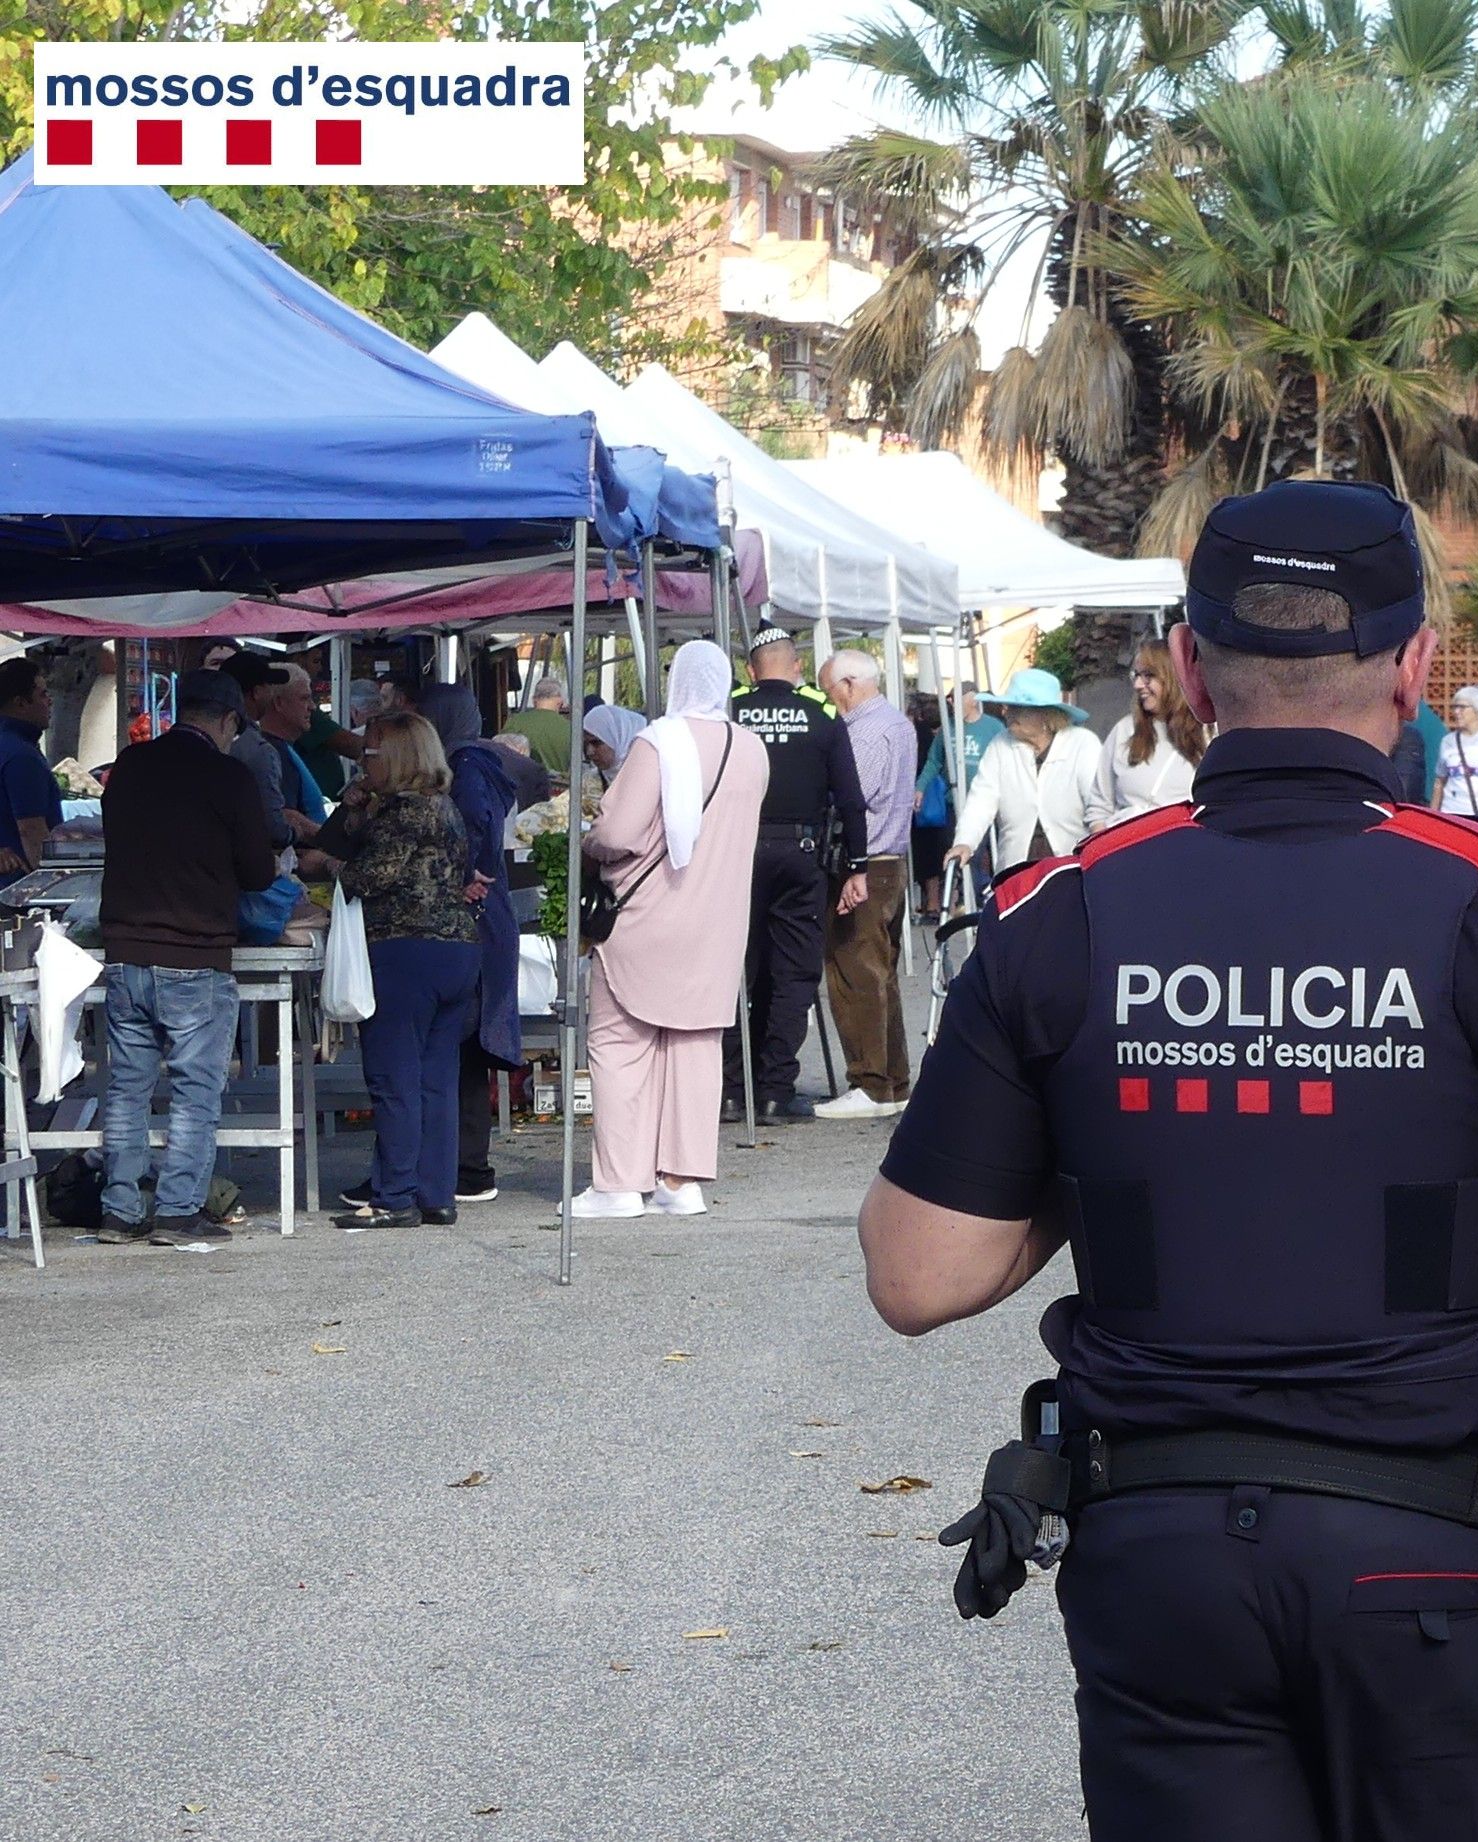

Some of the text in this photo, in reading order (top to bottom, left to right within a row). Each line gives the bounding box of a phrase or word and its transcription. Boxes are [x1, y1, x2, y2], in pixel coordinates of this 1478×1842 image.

[1253, 554, 1286, 566] mossos
[738, 708, 809, 723] POLICIA
[775, 723, 809, 733] Urbana
[1116, 964, 1424, 1030] POLICIA
[1116, 1041, 1236, 1066] mossos
